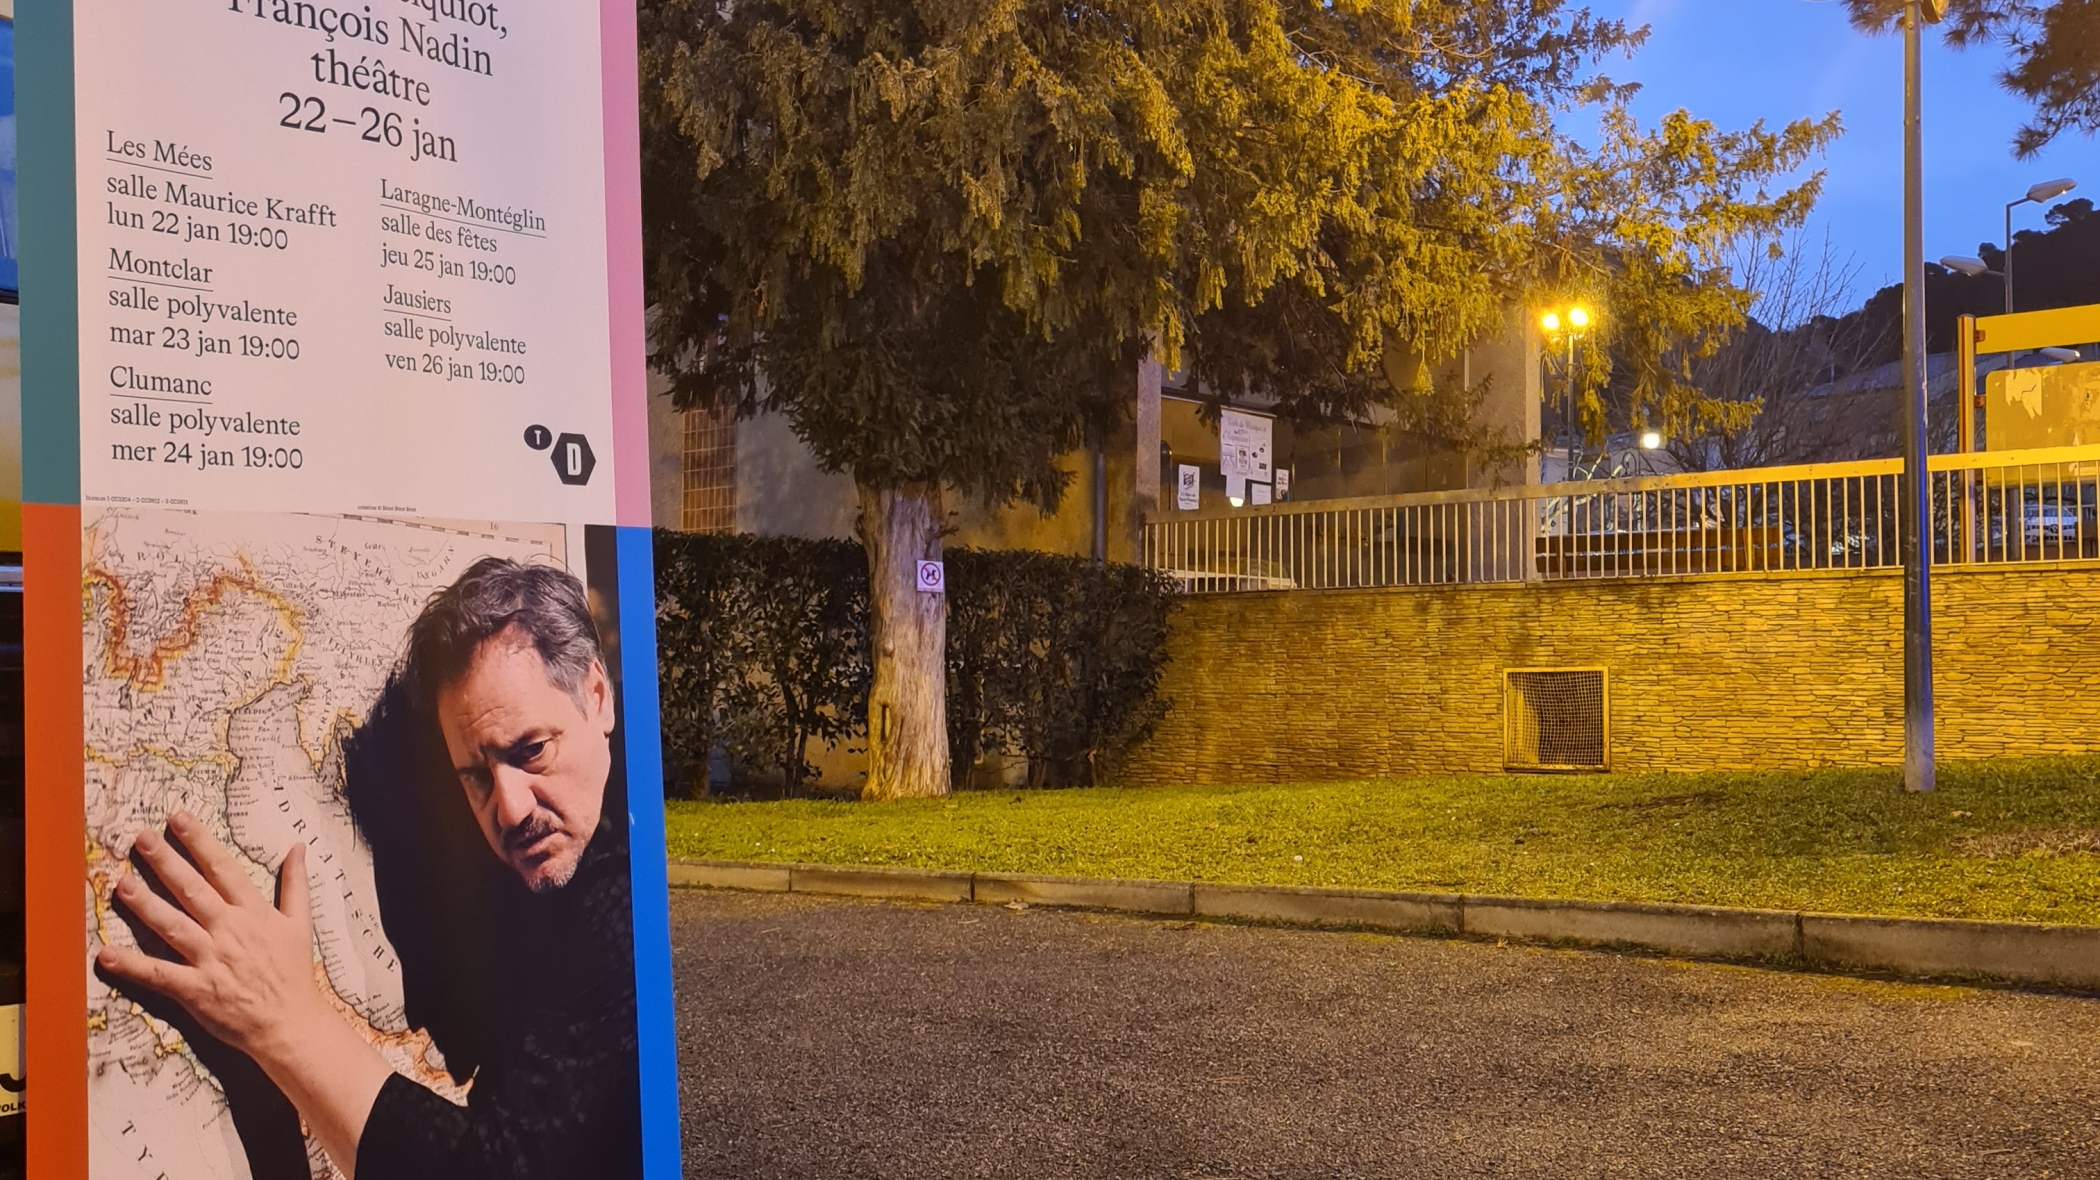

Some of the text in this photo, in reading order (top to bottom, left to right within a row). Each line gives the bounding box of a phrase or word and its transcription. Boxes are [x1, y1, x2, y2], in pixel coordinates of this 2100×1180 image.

[399, 16, 493, 76] Nadin
[311, 49, 430, 106] théâtre
[107, 130, 212, 171] Les Mées
[410, 118, 457, 162] jan
[107, 174, 337, 227] salle Maurice Krafft
[380, 179, 546, 232] Laragne-Montéglin
[107, 203, 288, 250] lun 22 jan 19:00
[381, 214, 497, 252] salle des fêtes
[109, 247, 213, 283] Montclar
[380, 242, 515, 285] jeu 25 jan 19:00
[109, 286, 297, 326] salle polyvalente
[384, 284, 451, 313] Jausiers
[110, 327, 299, 360] mar 23 jan 19:00
[385, 318, 526, 354] salle polyvalente
[110, 366, 212, 395] Clumanc
[385, 354, 524, 384] ven 26 jan 19:00
[111, 403, 300, 436] salle polyvalente
[111, 441, 303, 470] mer 24 jan 19:00
[567, 443, 582, 475] D
